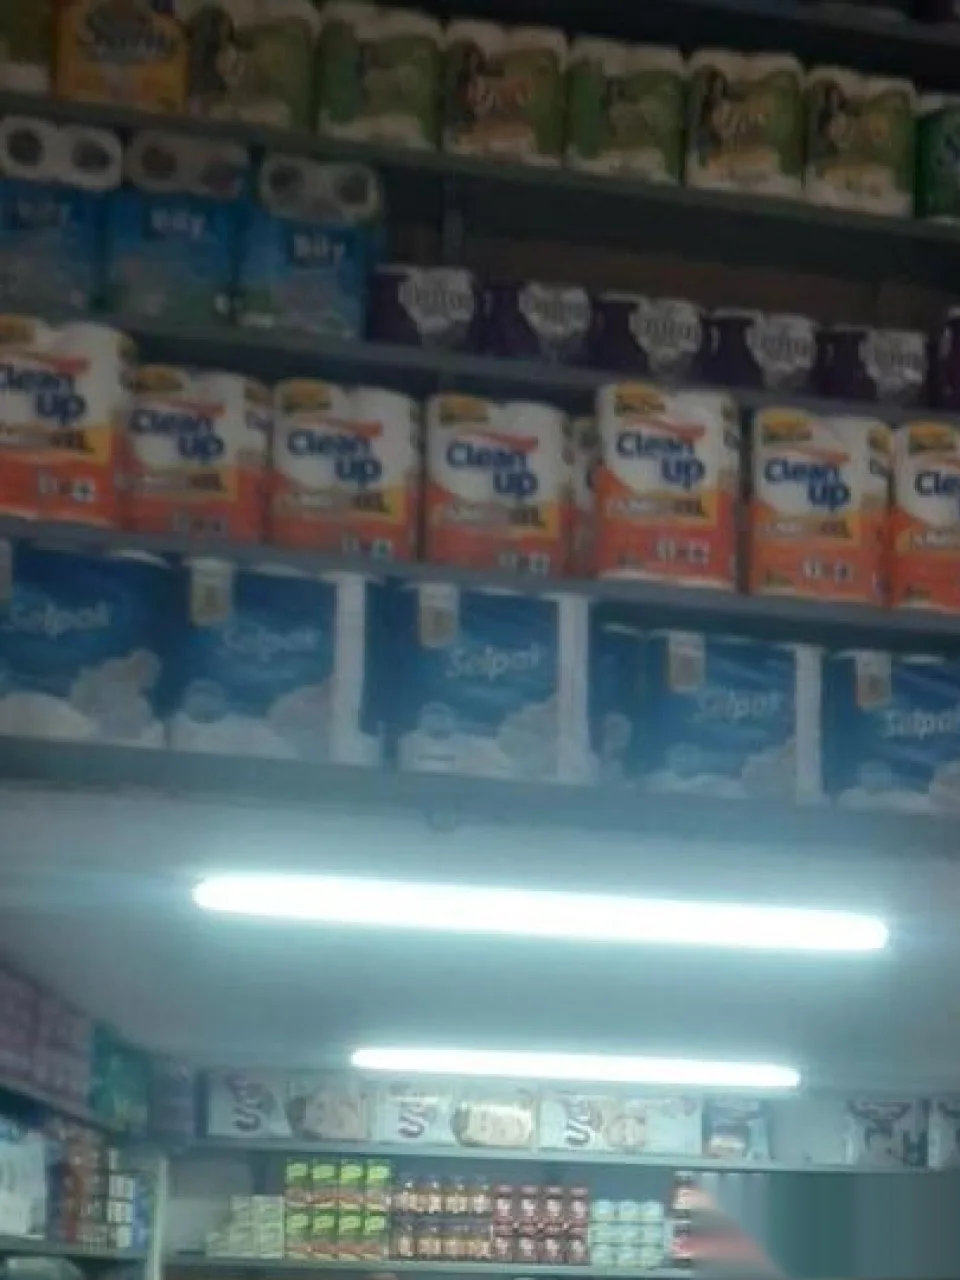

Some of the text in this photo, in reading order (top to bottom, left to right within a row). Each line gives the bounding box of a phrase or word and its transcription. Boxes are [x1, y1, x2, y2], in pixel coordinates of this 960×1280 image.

[129, 408, 213, 437] Clean
[287, 429, 370, 457] Clean
[446, 441, 528, 467] Clean
[616, 431, 694, 458] Clean
[764, 457, 841, 482] Clean
